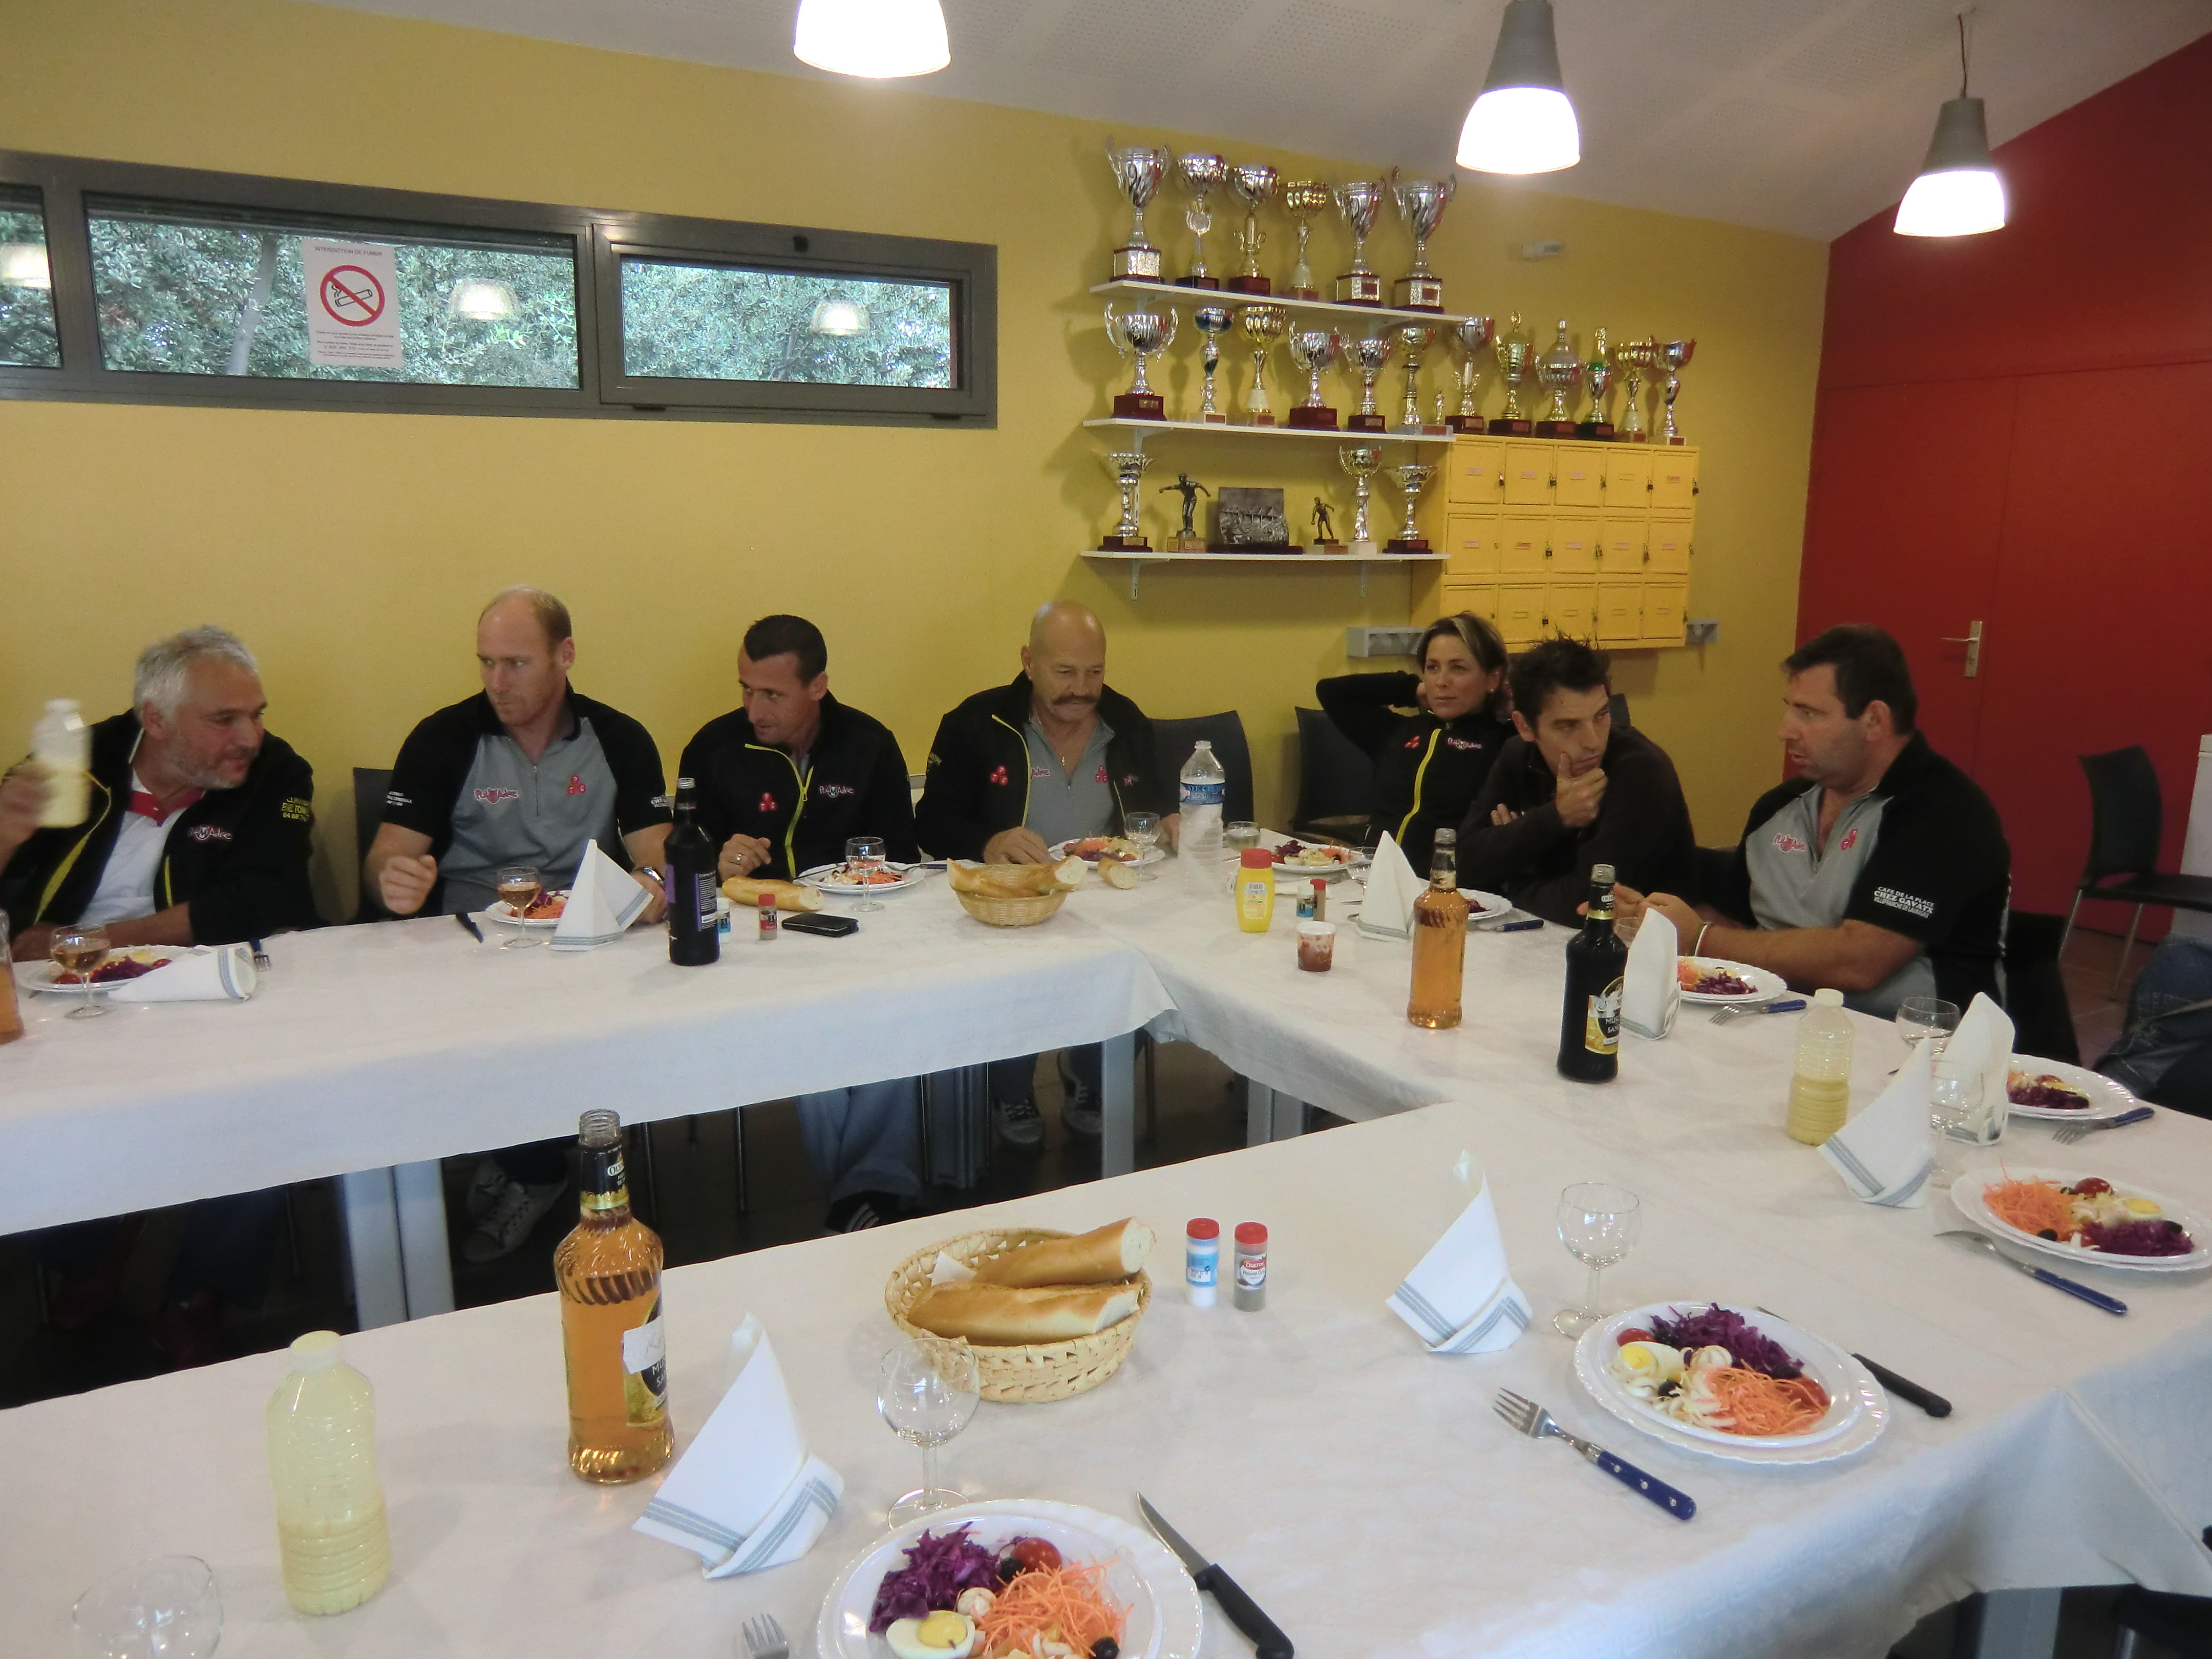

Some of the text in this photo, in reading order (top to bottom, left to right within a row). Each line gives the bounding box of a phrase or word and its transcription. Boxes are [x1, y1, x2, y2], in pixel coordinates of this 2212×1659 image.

[315, 246, 354, 255] INTERDICTION
[1874, 890, 1934, 913] CHEZ GAVATX
[1878, 886, 1895, 895] CAFE
[1915, 897, 1935, 907] PLACE
